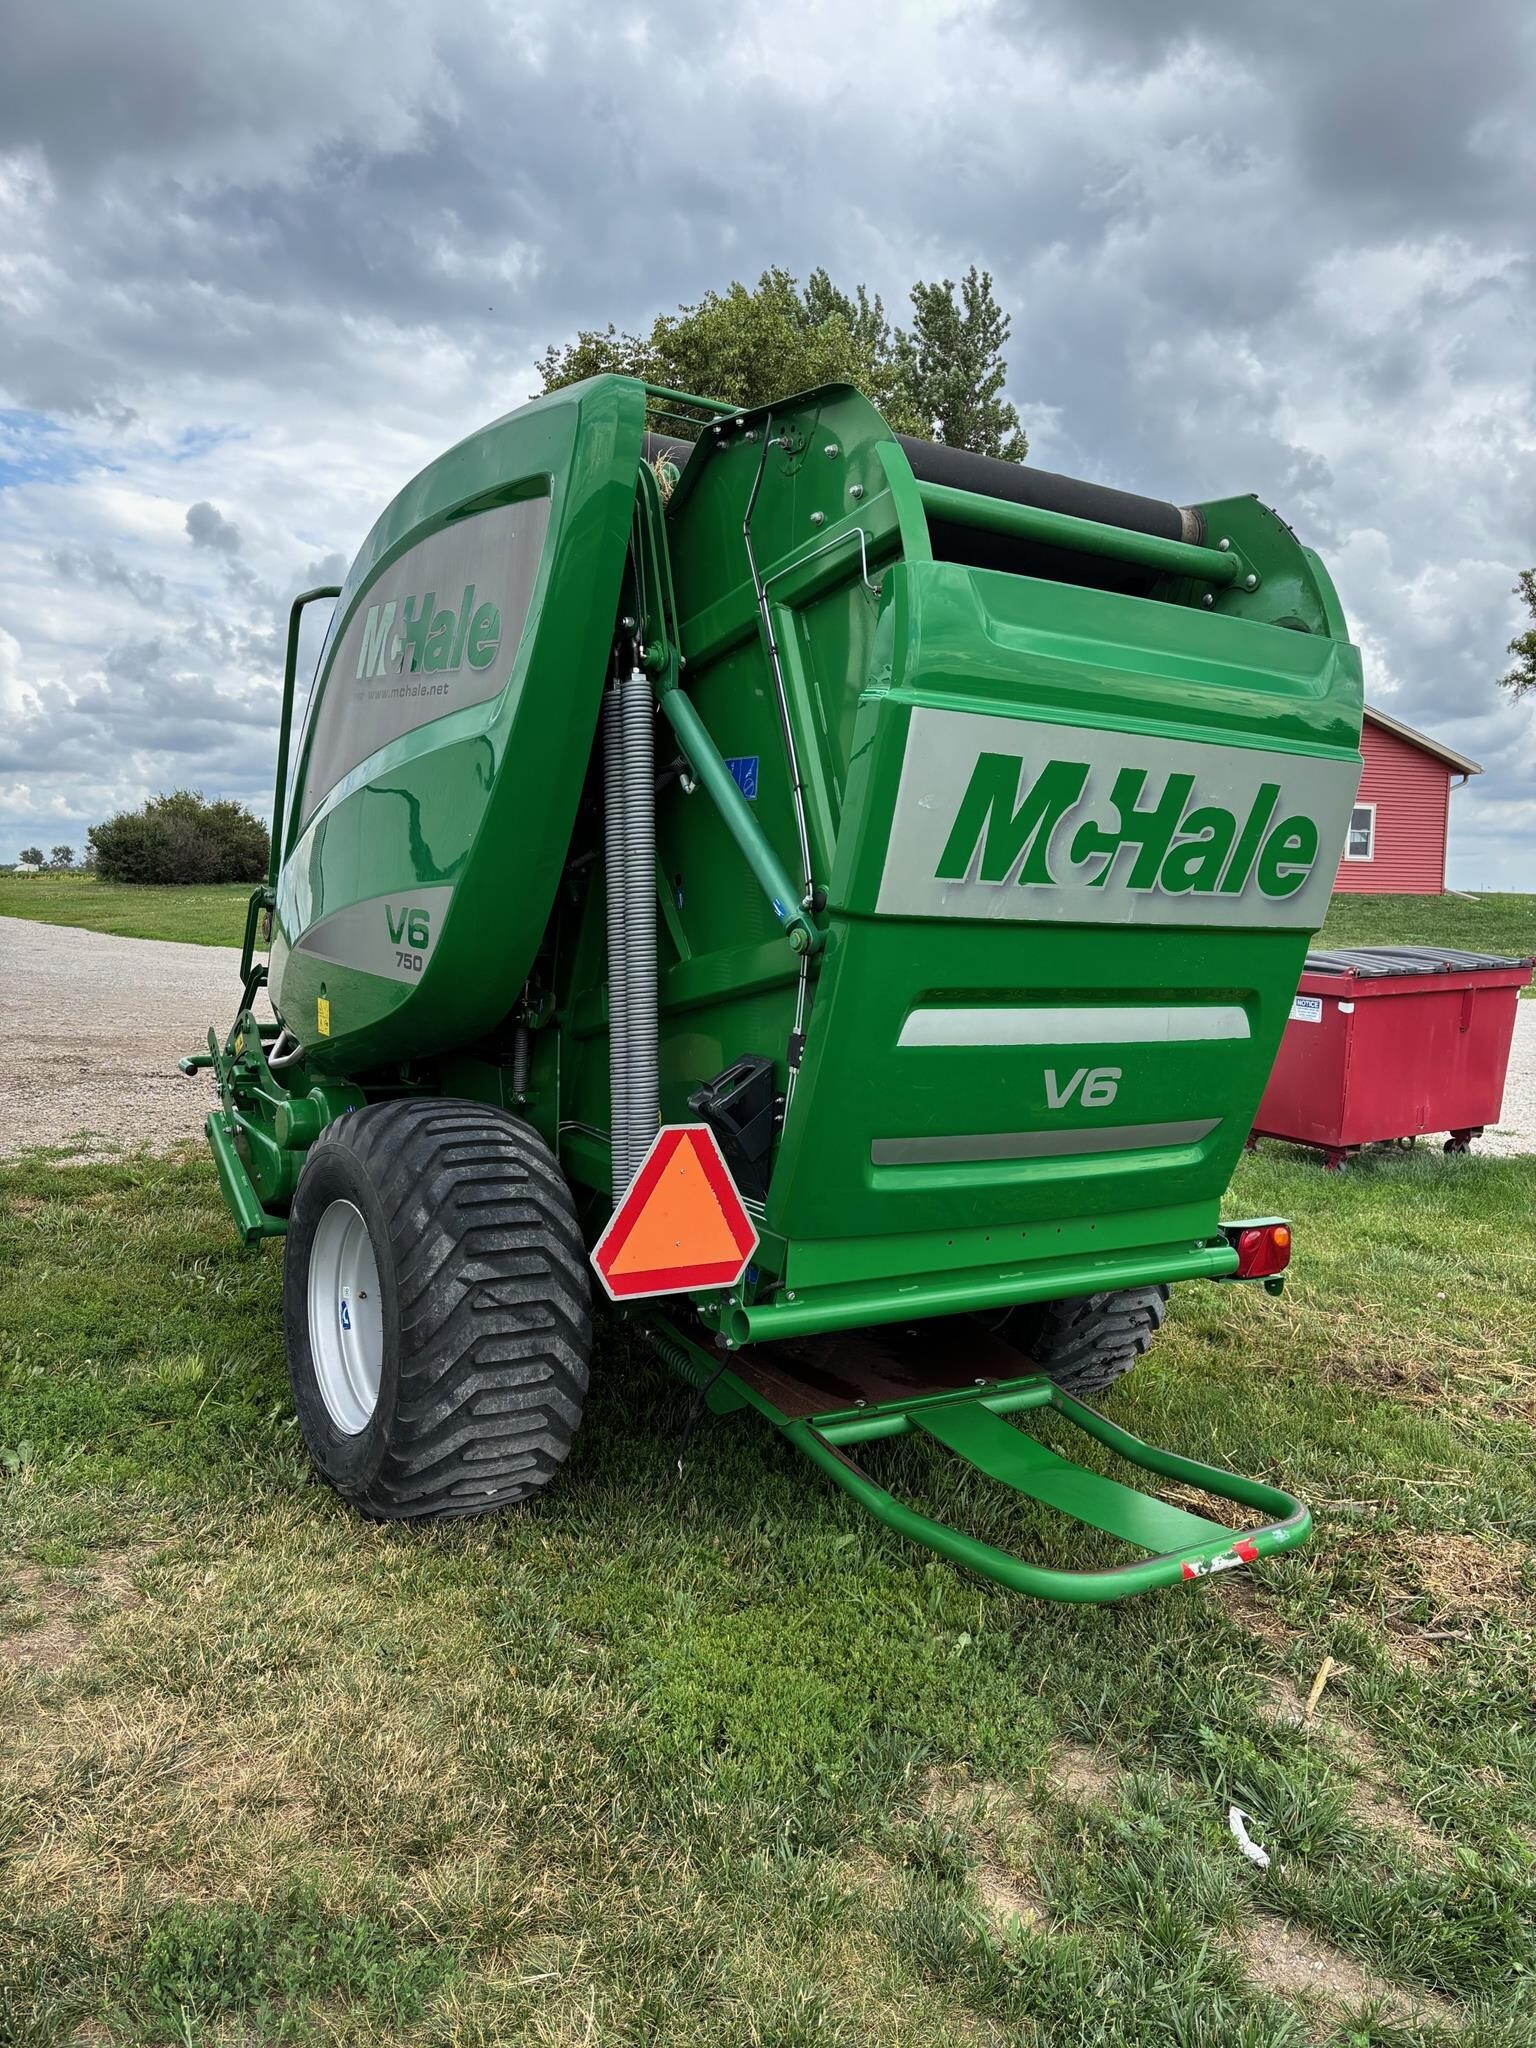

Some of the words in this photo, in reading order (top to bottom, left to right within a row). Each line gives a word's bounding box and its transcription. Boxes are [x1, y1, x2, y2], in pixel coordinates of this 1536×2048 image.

[355, 583, 501, 680] McHale
[368, 682, 449, 700] www.mchale.net
[934, 752, 1319, 899] McHale
[385, 904, 430, 950] V6
[395, 951, 423, 972] 750
[1297, 999, 1319, 1009] NOTICE
[1043, 1067, 1122, 1109] V6
